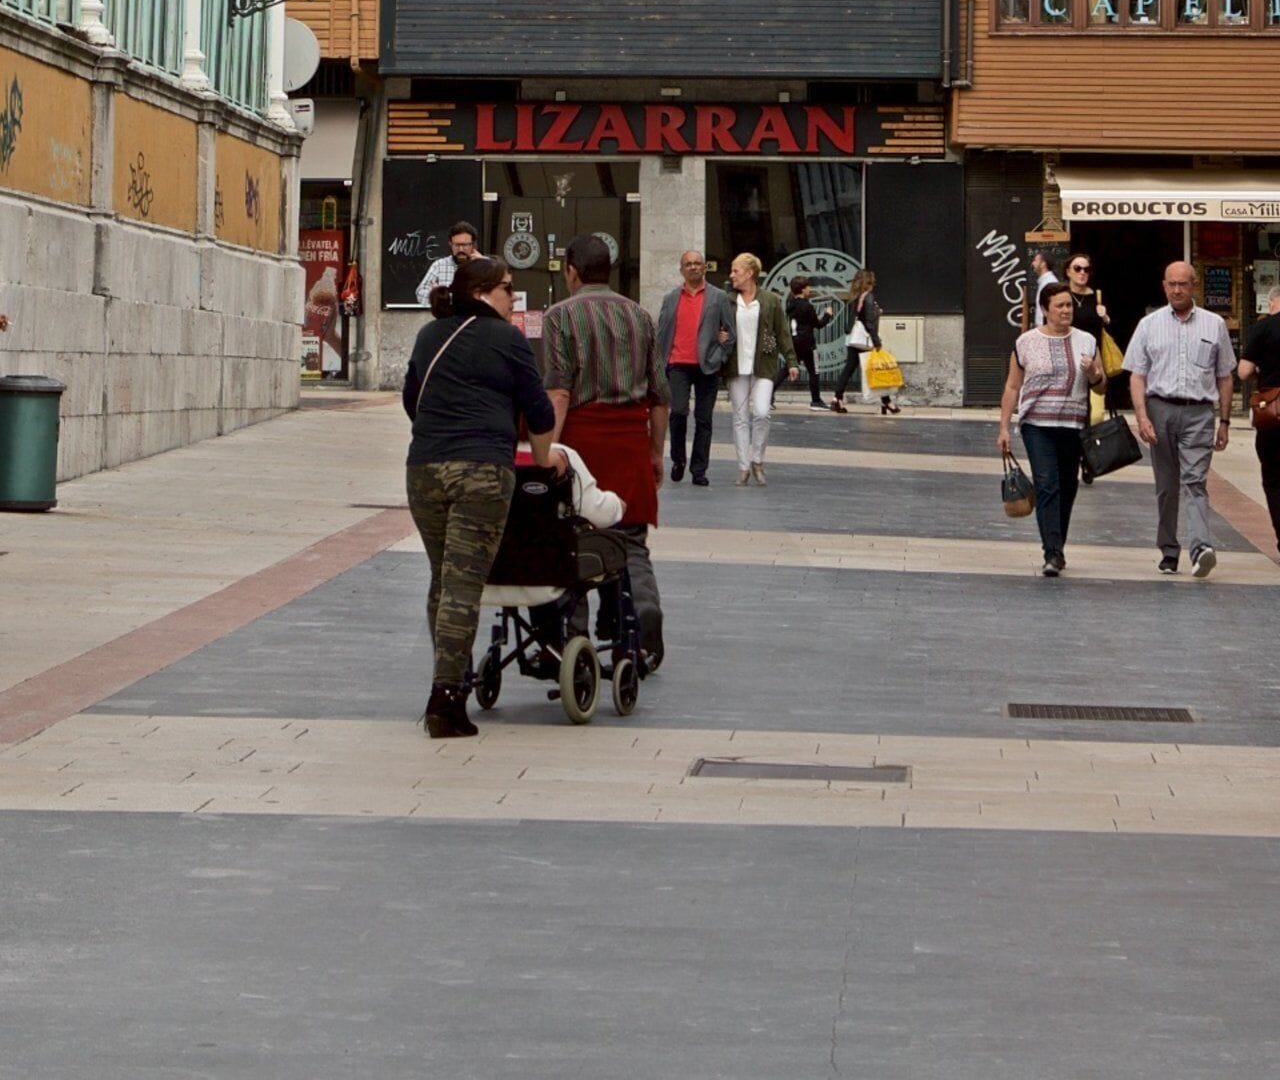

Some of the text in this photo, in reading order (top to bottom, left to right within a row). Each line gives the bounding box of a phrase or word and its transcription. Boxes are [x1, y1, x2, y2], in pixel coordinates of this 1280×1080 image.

[474, 103, 857, 154] LIZARRAN
[1071, 201, 1208, 216] PRODUCTOS
[1224, 207, 1248, 216] CASA
[318, 249, 340, 262] FRÍA
